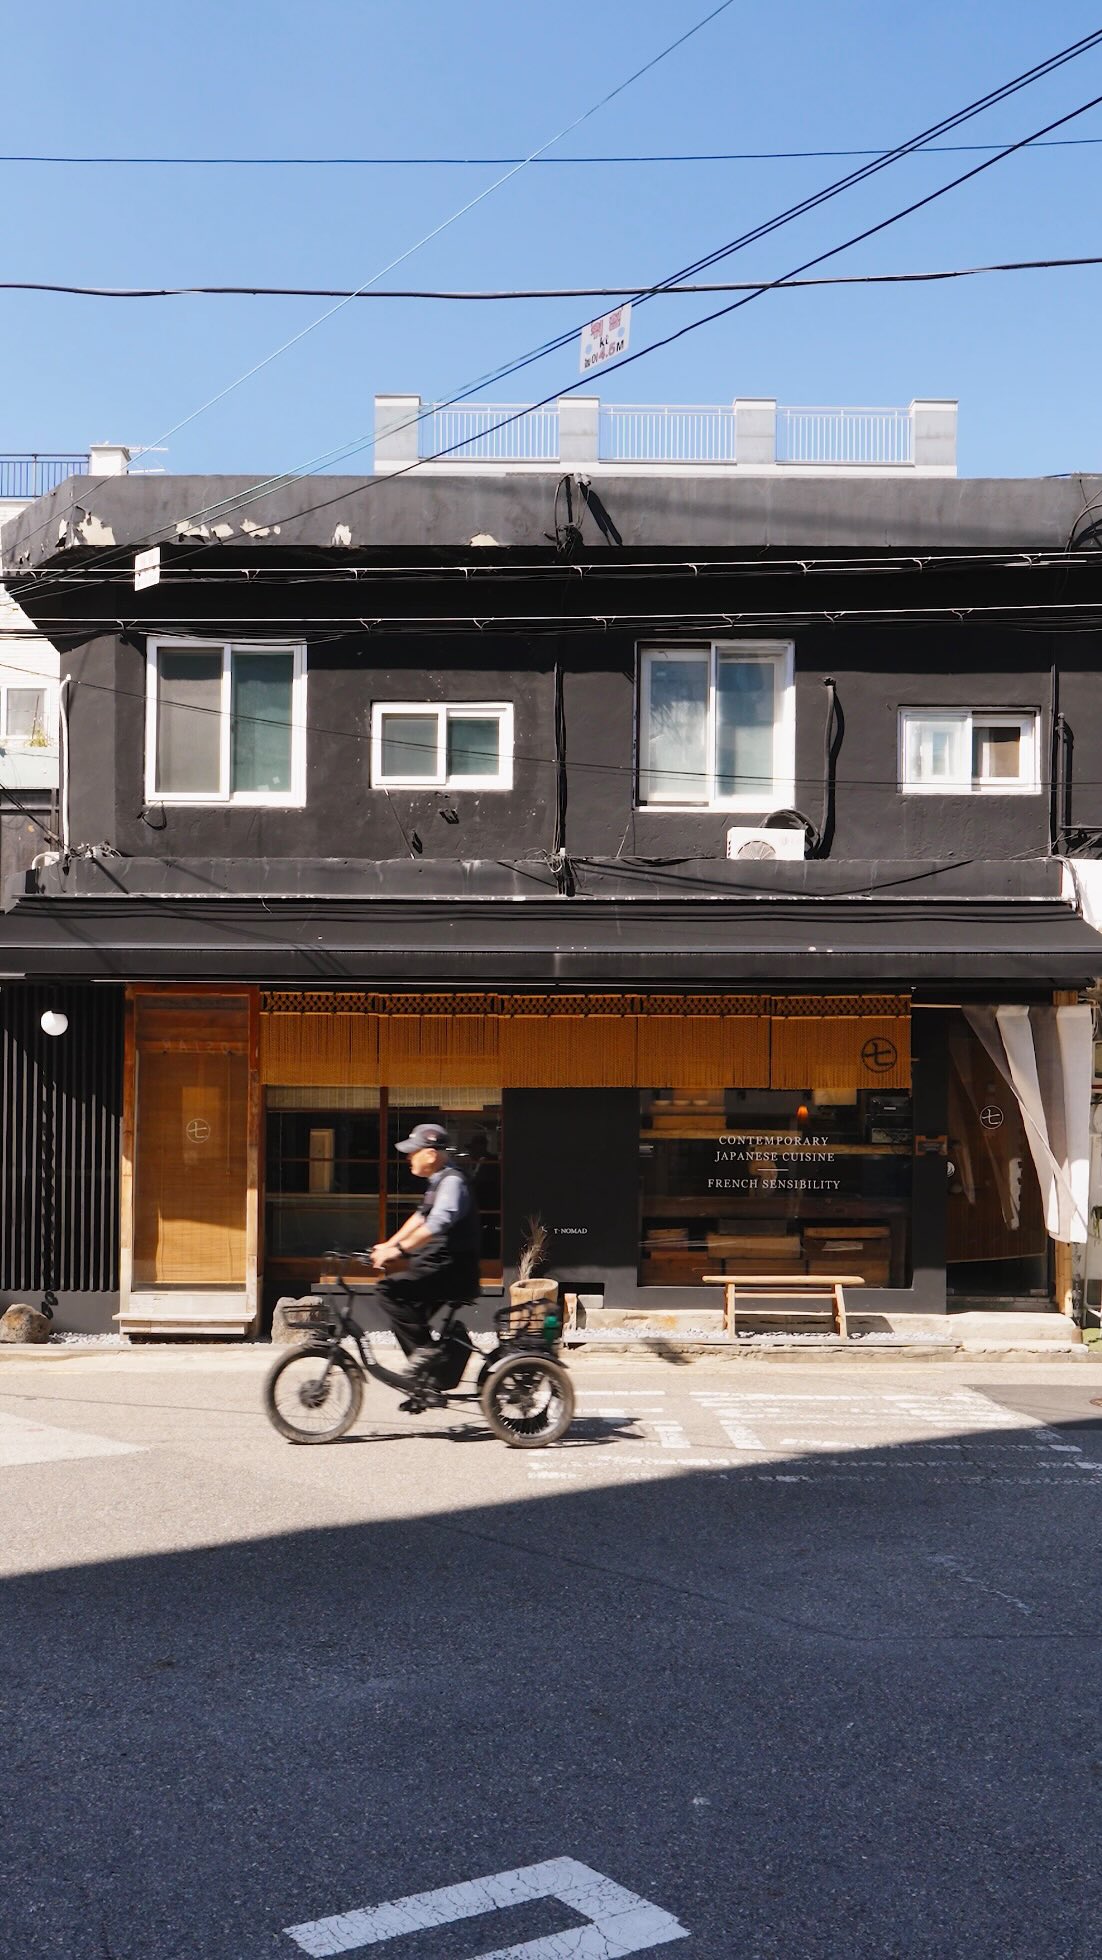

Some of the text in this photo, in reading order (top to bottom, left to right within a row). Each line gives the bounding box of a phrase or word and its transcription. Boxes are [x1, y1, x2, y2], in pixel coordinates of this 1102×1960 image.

[718, 1135, 829, 1146] CONTEMPORARY
[715, 1151, 835, 1162] JAPANESE CUISINE
[707, 1178, 841, 1190] FRENCH SENSIBILITY
